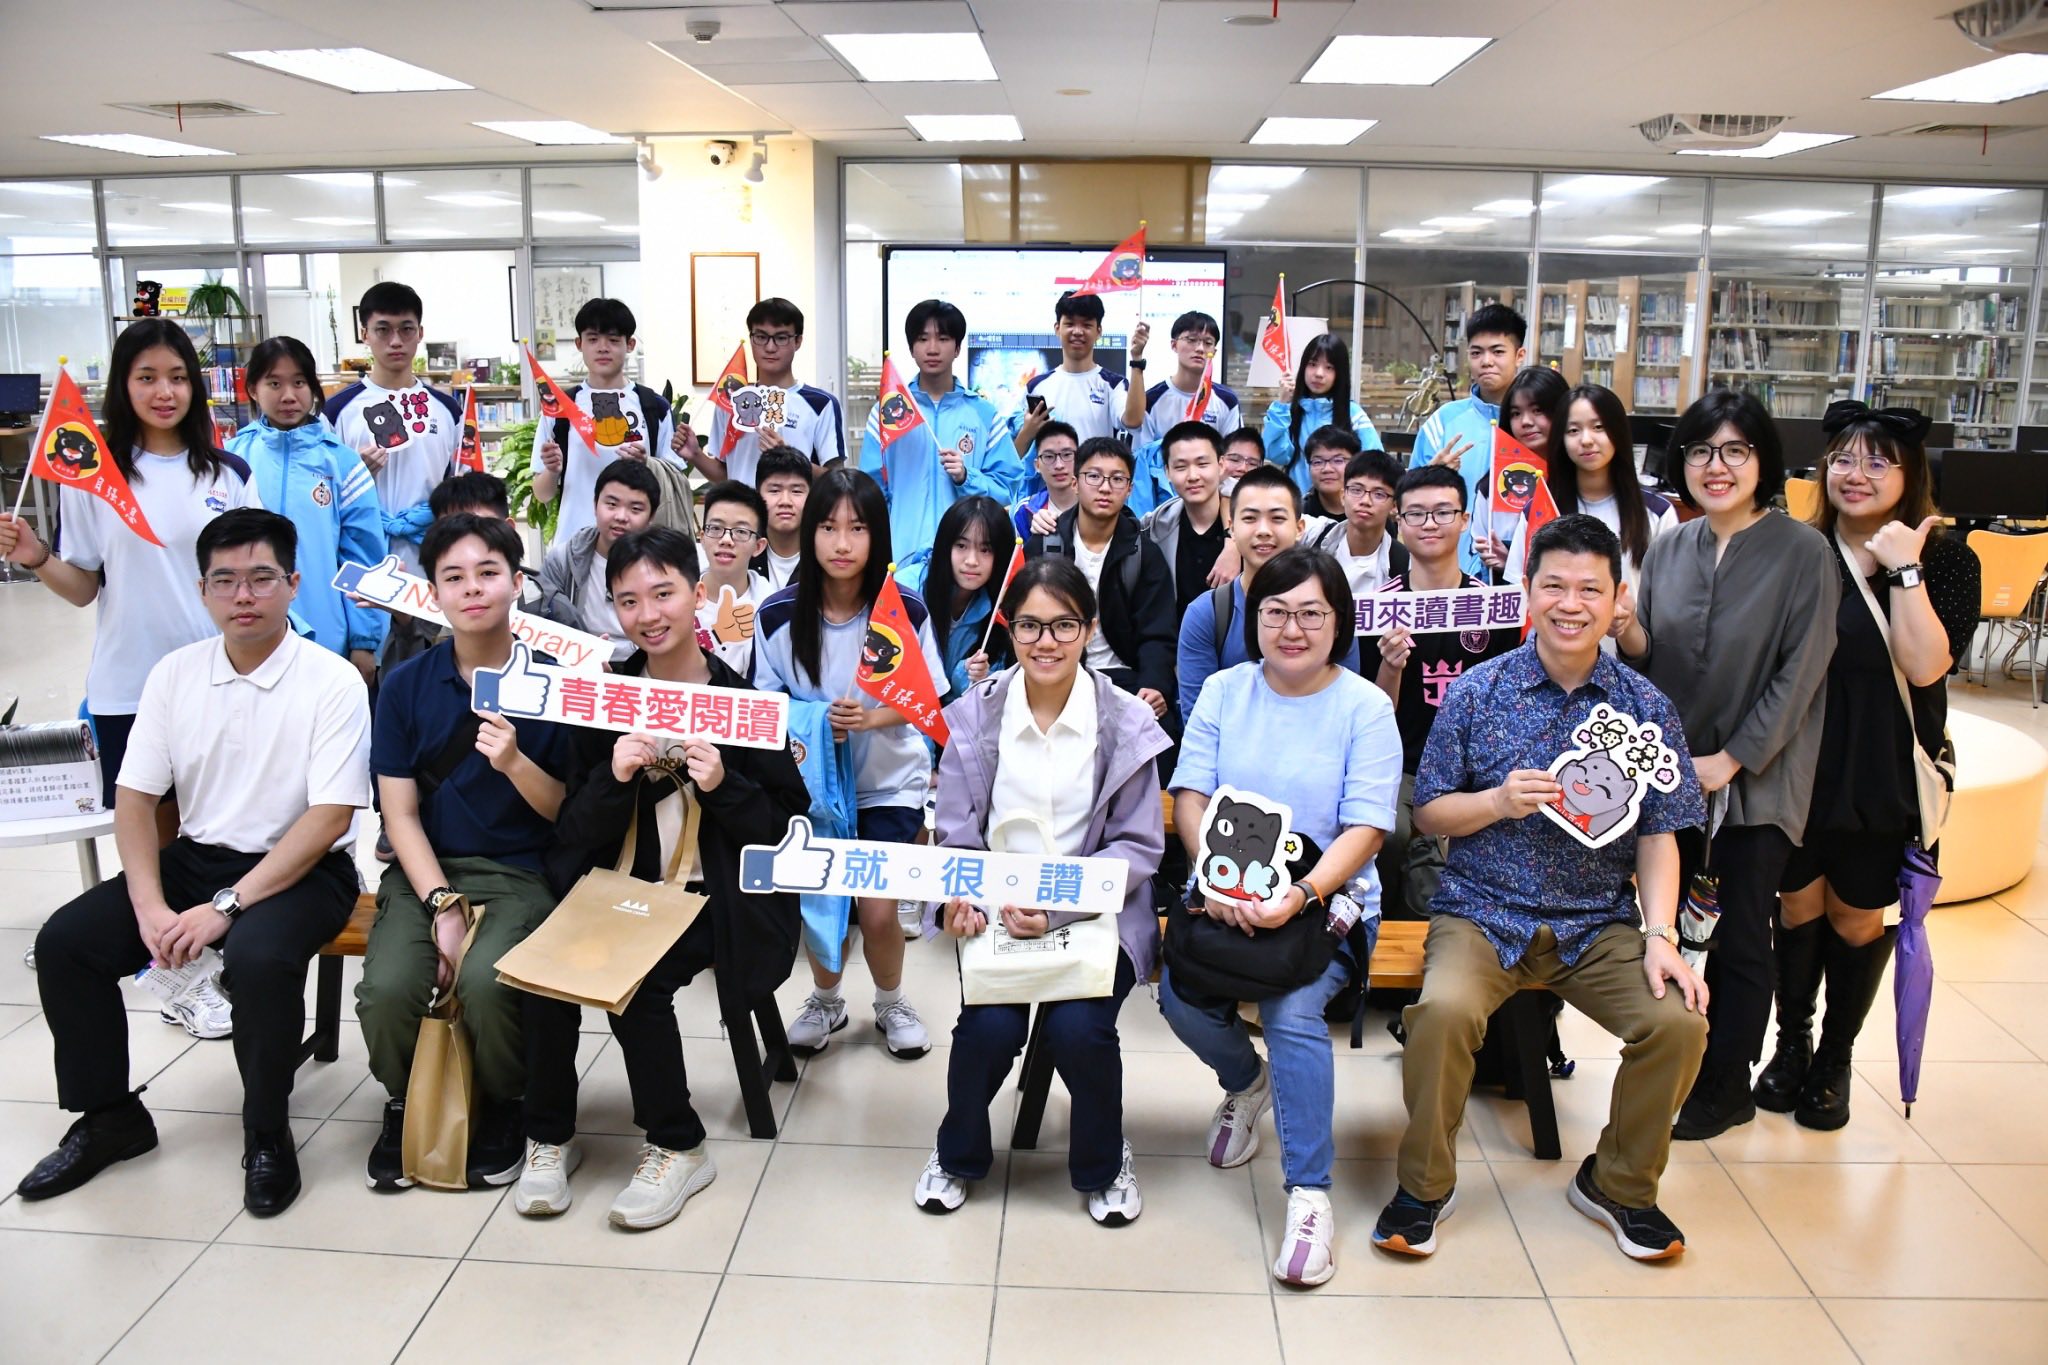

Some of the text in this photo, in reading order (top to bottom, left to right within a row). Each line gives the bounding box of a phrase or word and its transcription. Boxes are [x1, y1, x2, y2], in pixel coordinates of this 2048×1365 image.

[510, 615, 594, 666] ibrary
[559, 677, 780, 744] 青春愛閱讀
